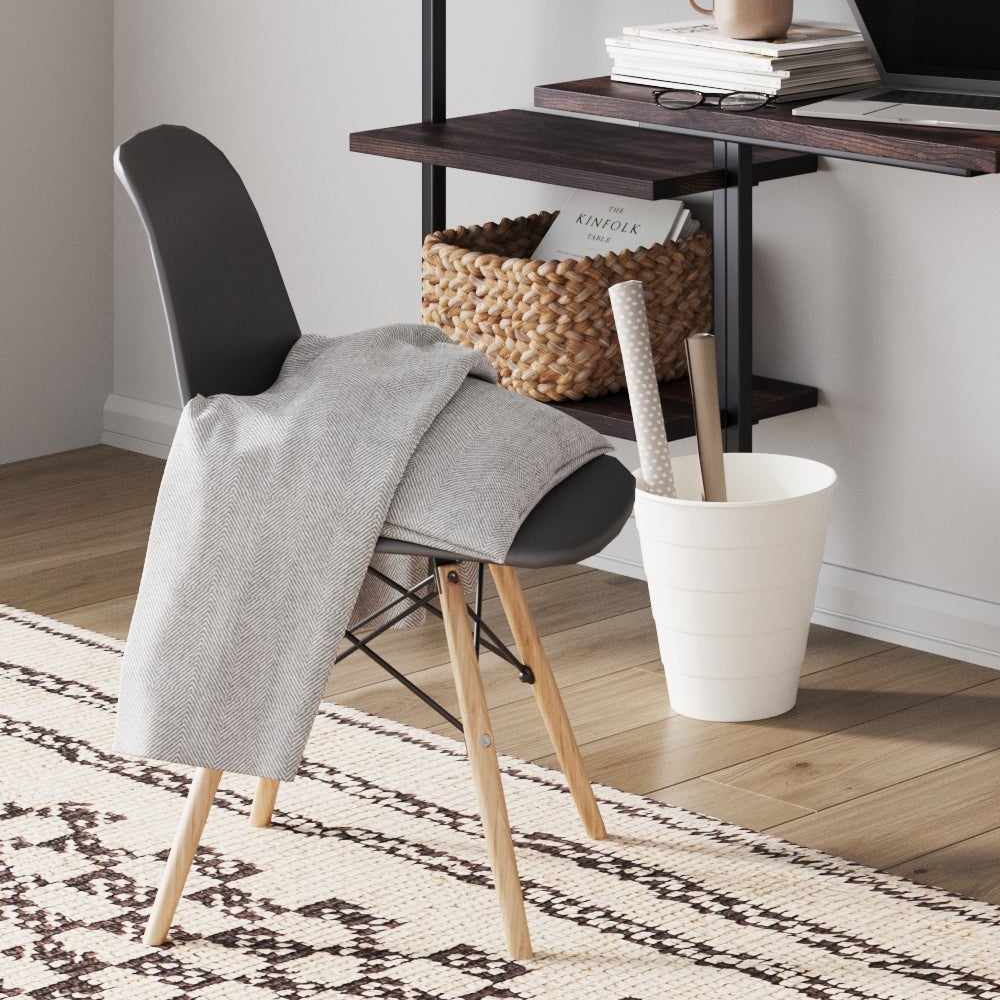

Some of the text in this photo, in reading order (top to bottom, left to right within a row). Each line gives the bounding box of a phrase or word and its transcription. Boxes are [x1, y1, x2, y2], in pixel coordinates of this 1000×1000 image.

[608, 206, 625, 215] THE
[575, 213, 642, 235] KINFOLK
[586, 233, 613, 244] TABLE
